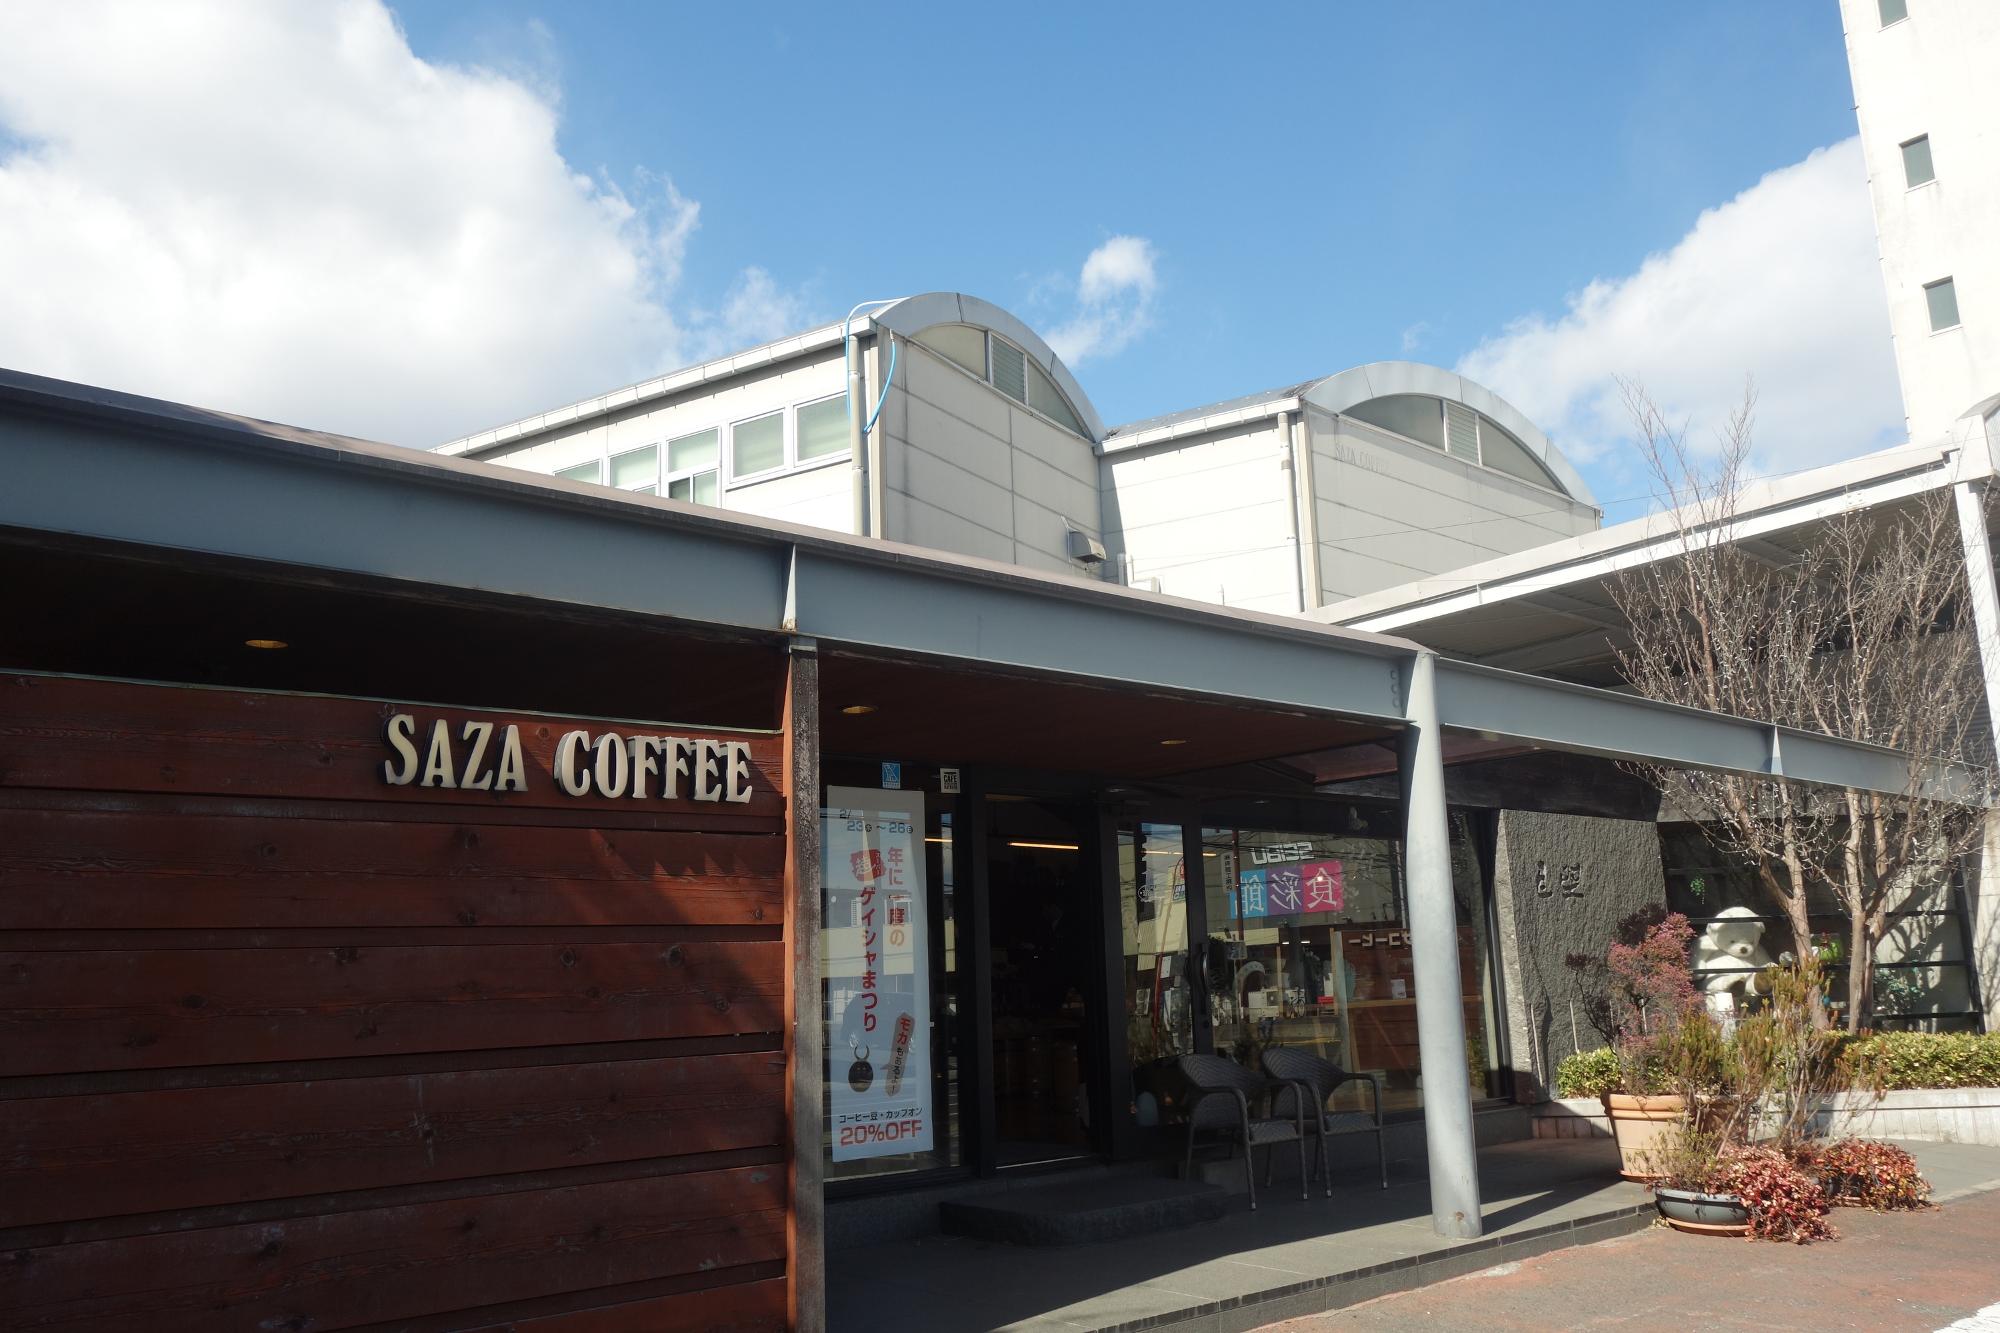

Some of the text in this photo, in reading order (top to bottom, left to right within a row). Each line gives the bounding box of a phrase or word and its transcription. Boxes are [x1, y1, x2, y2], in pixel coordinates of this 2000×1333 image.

[383, 713, 753, 804] SAZA COFFEE
[887, 846, 906, 947] 年に一度の
[860, 887, 878, 1032] ゲイシャまつり
[840, 1119, 922, 1146] 20%OFF
